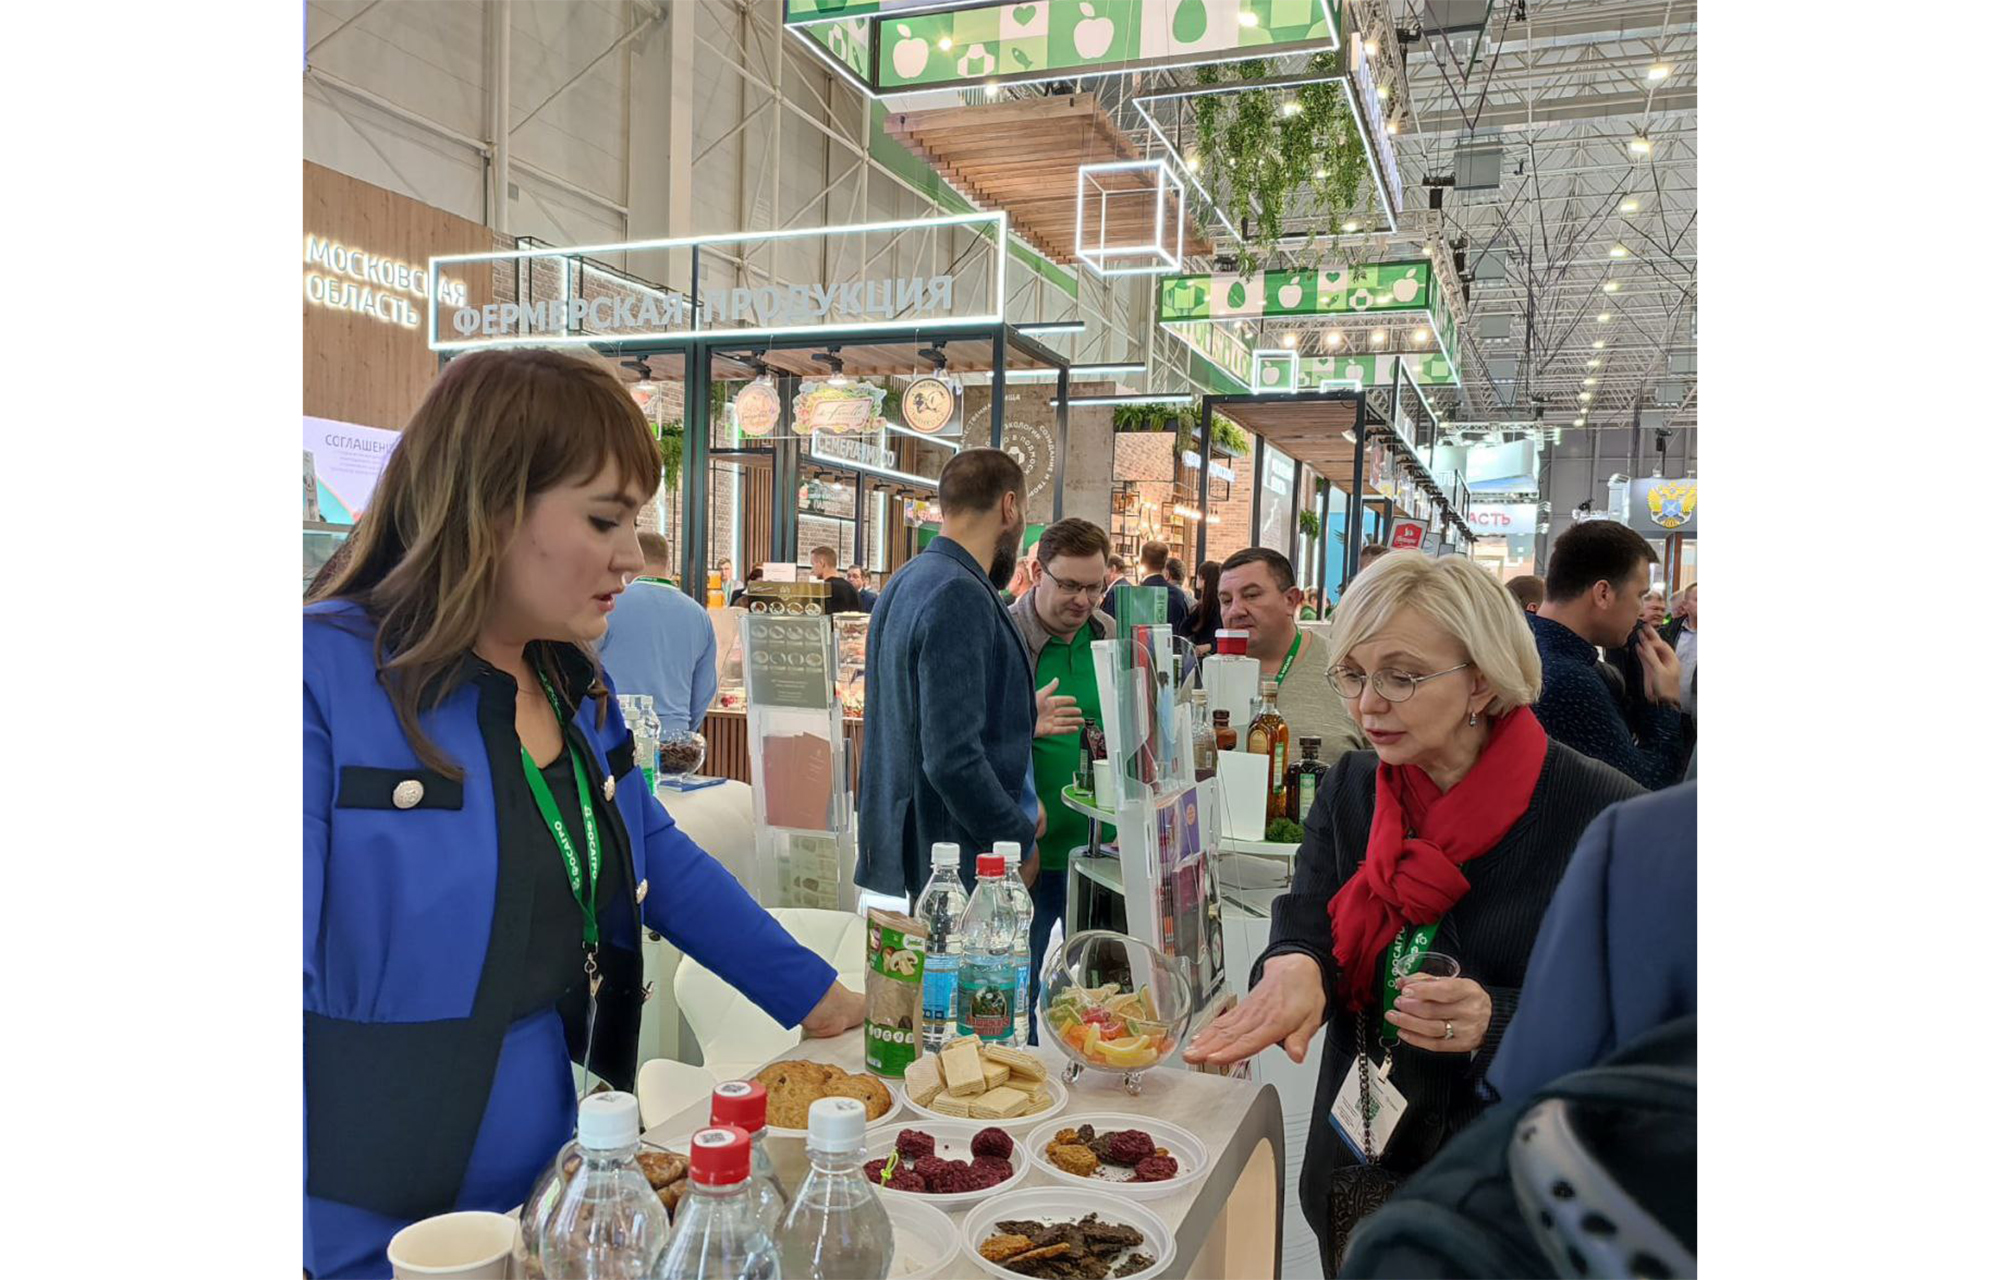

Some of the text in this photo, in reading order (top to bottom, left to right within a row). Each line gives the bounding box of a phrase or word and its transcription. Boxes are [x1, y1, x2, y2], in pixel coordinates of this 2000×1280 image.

[308, 273, 419, 327] ОБЛАСТЬ
[453, 275, 953, 336] ФЕРМЕРСКАЯ ПРОДУКЦИЯ
[1020, 436, 1036, 475] ПОДМОСК
[554, 820, 580, 877] ФОСАГРО
[586, 820, 598, 880] ФОСАГРО
